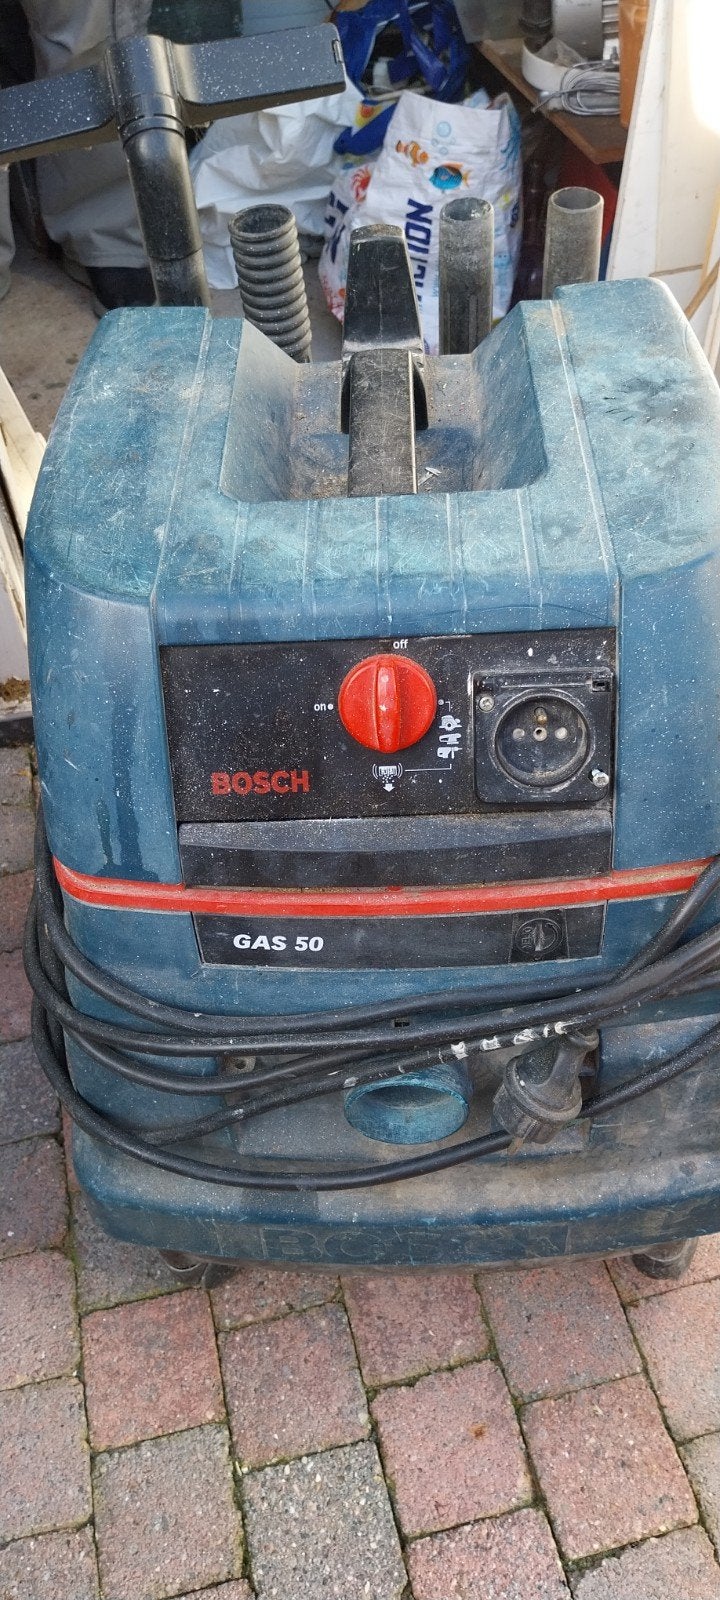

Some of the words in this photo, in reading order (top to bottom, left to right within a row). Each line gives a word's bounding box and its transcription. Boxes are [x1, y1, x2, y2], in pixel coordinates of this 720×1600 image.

[393, 639, 409, 649] off
[313, 702, 327, 712] on
[211, 768, 310, 795] BOSCH
[233, 933, 287, 951] GAS
[294, 936, 324, 952] 50
